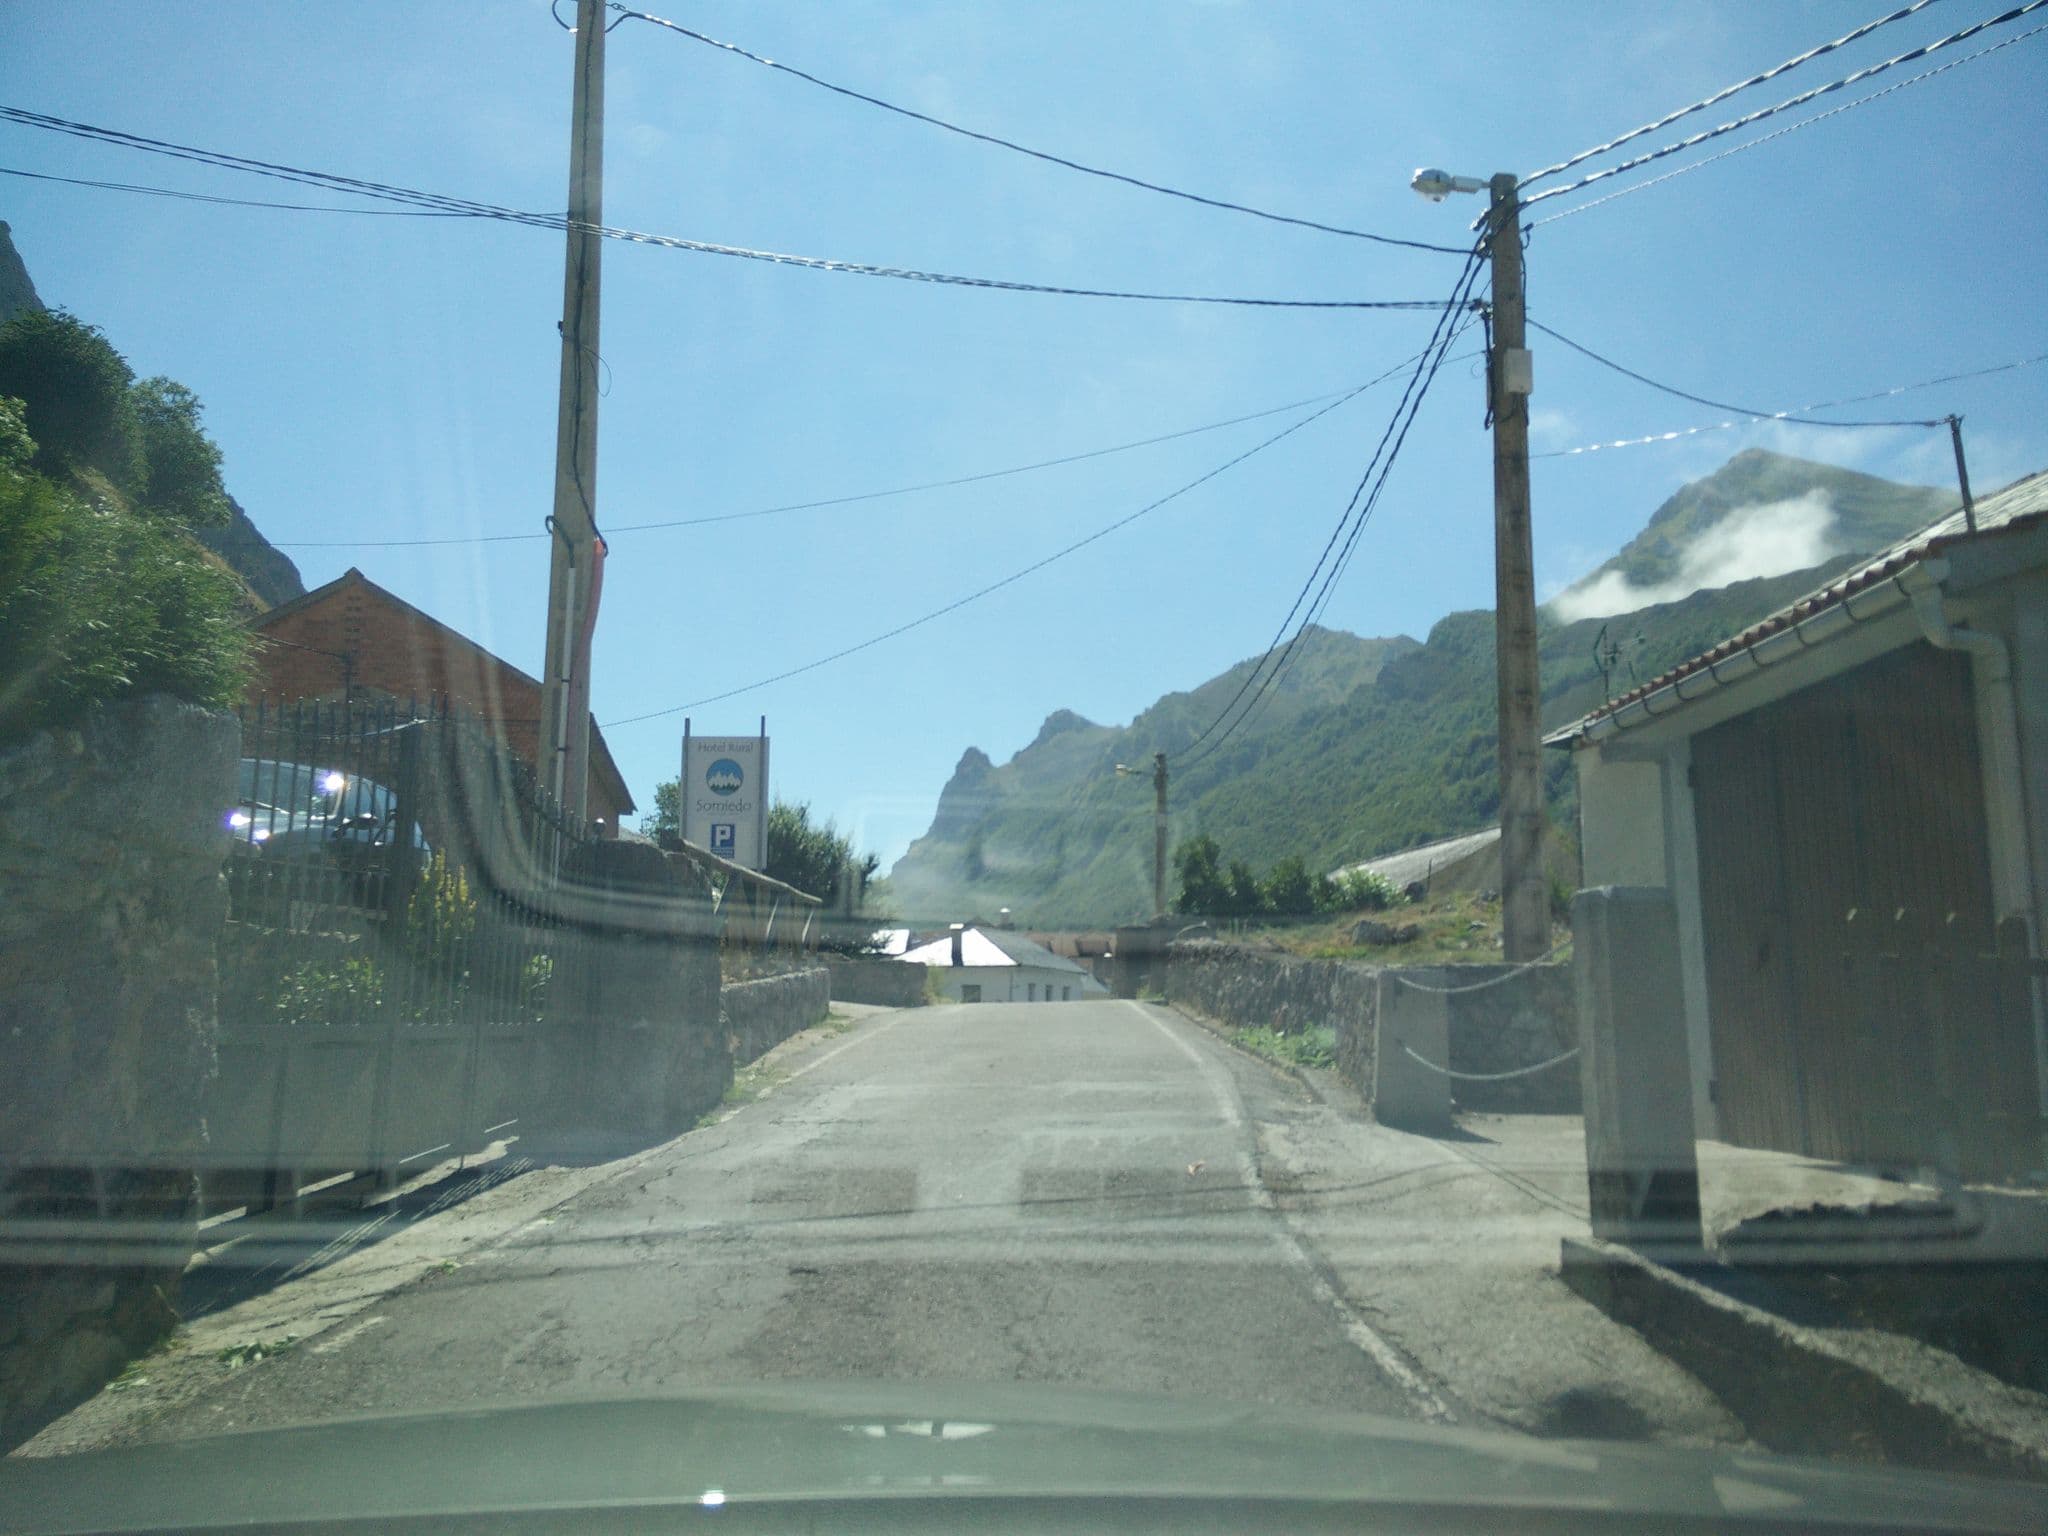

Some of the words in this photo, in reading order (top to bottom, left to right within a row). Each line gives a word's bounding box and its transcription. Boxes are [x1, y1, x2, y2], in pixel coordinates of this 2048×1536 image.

[698, 742, 726, 752] Hotel
[728, 742, 753, 752] Rural
[697, 799, 751, 813] Somiedo
[716, 826, 731, 847] P
